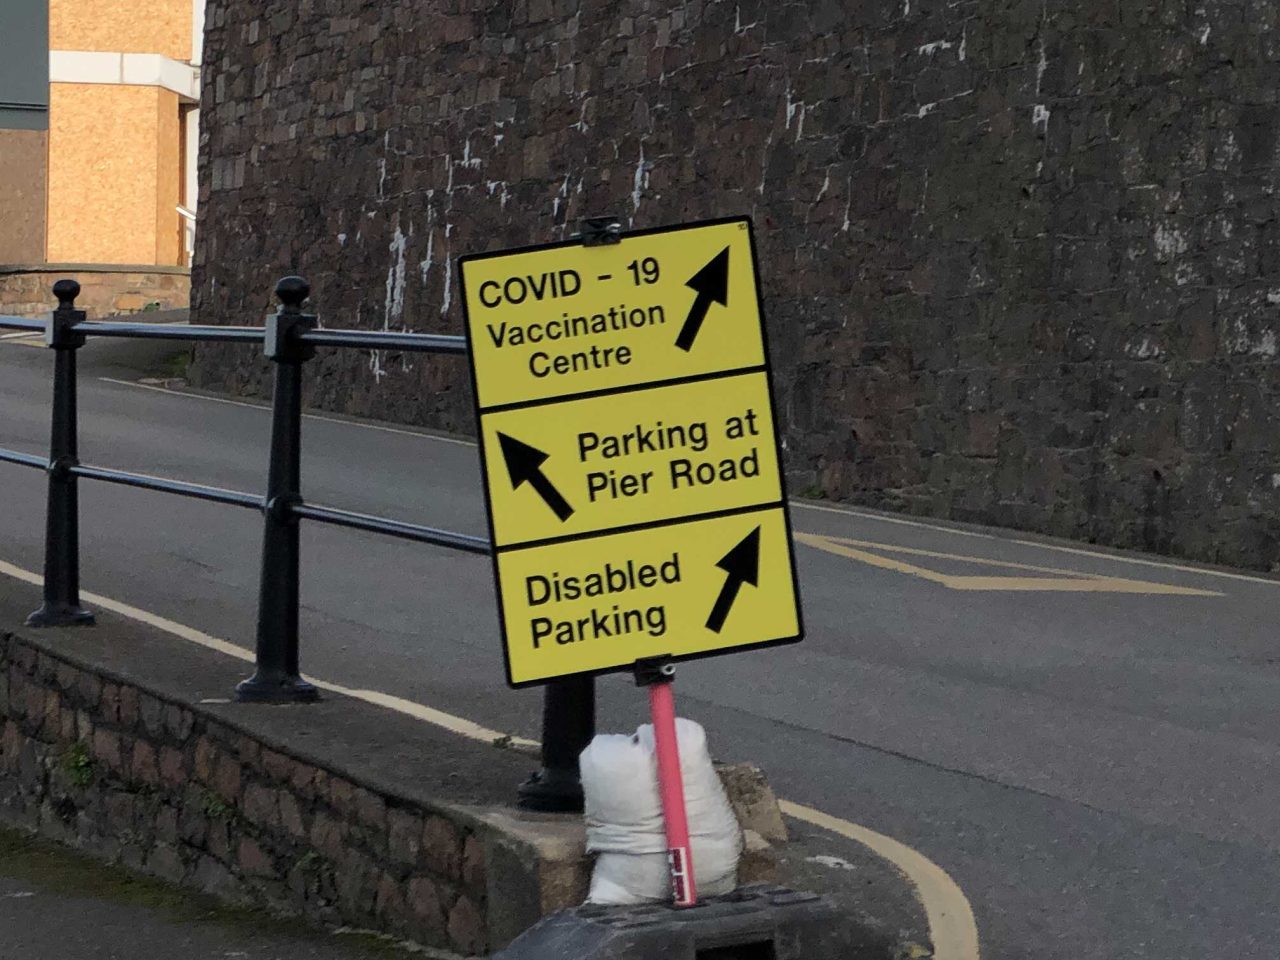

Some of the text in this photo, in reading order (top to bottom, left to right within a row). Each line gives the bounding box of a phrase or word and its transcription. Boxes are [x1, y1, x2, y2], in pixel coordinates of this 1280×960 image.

[478, 269, 582, 309] COVID
[626, 256, 660, 287] 19
[487, 304, 665, 348] Vaccination
[528, 345, 632, 378] Centre
[577, 408, 759, 462] Parking at
[586, 448, 760, 503] Pier Road
[525, 552, 681, 606] Disabled
[530, 605, 667, 649] Parking
